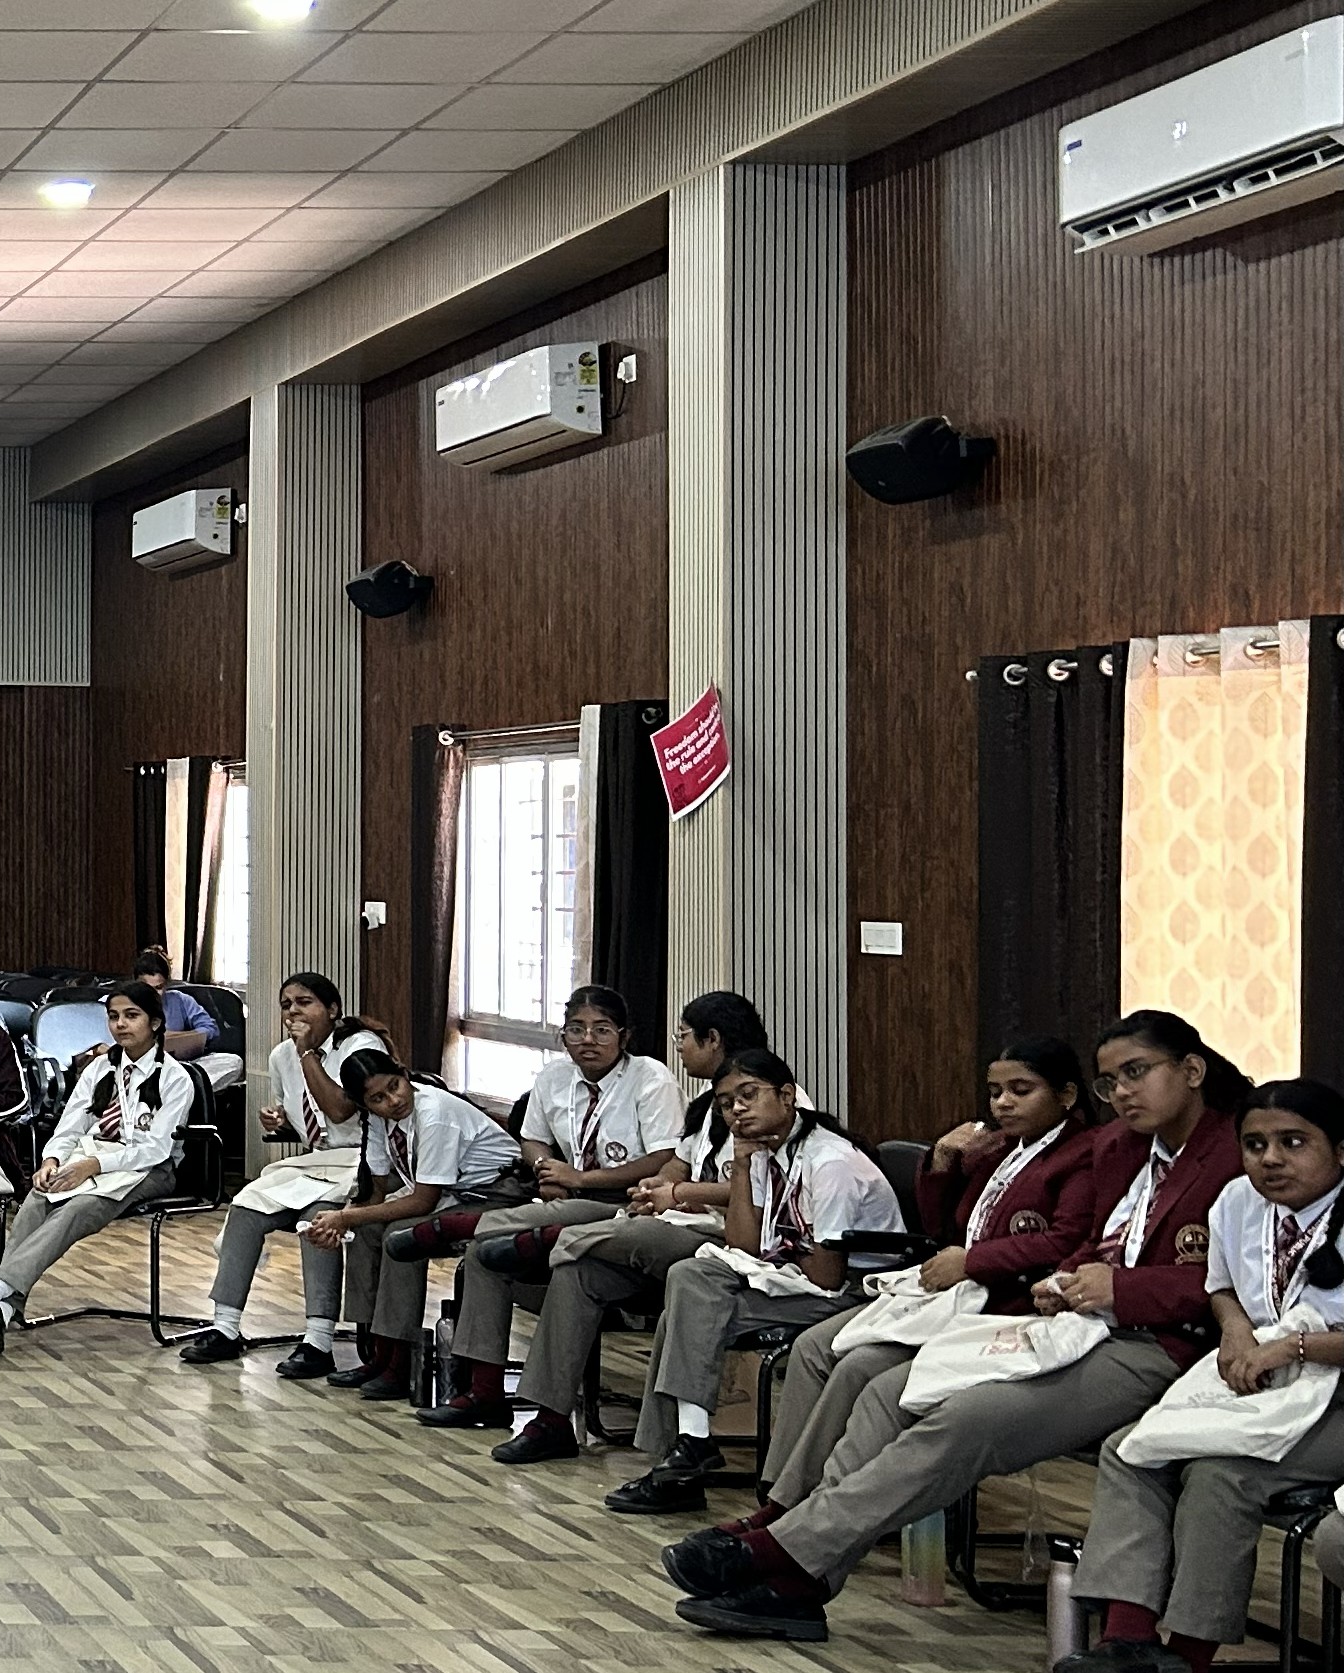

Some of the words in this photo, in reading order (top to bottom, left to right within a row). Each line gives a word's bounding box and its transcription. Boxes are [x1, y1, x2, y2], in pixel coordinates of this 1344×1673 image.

[664, 730, 699, 759] Freedom
[665, 757, 681, 771] the
[680, 744, 696, 761] rule
[695, 729, 710, 749] and
[679, 760, 693, 775] the
